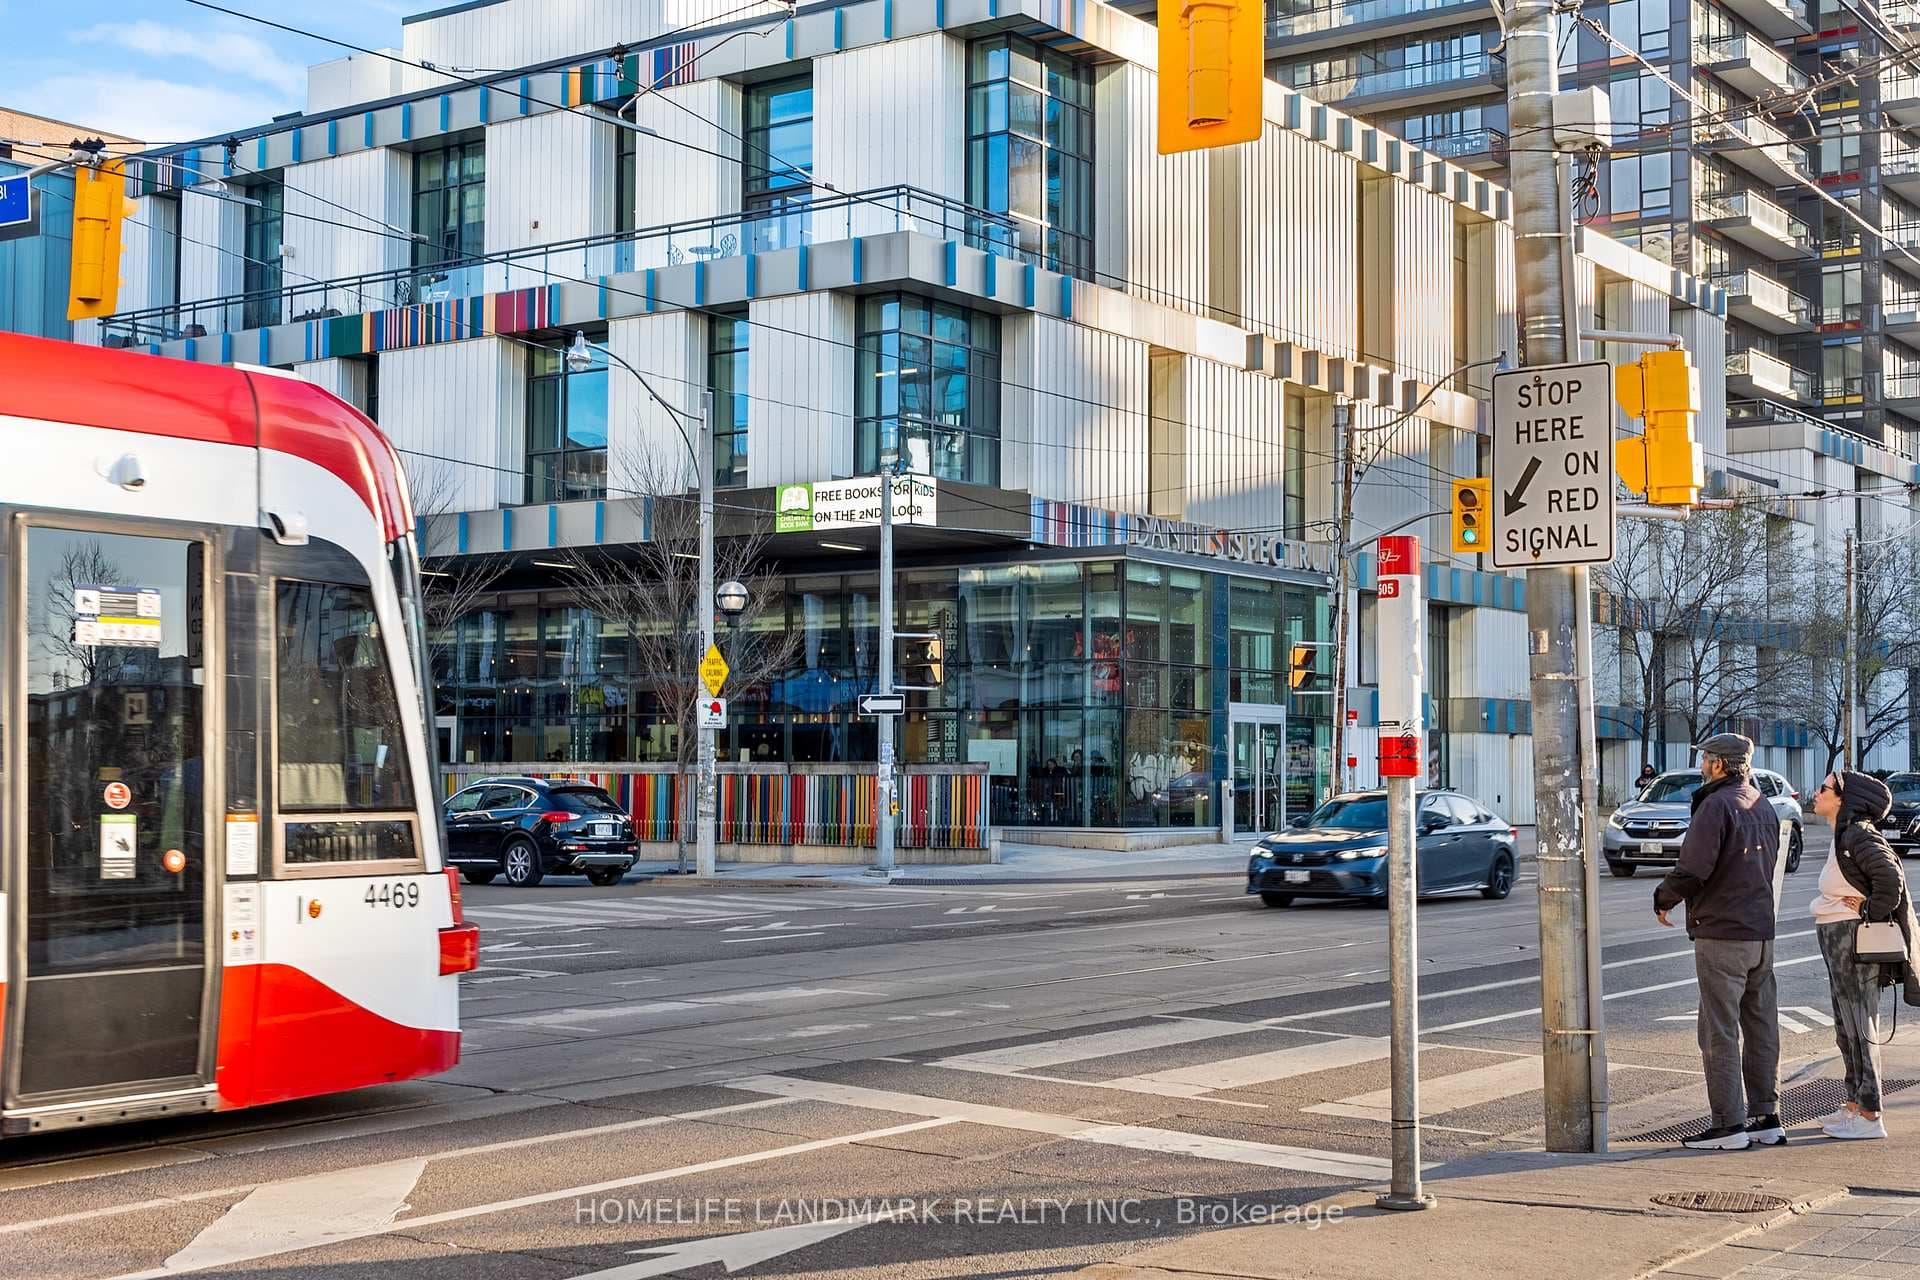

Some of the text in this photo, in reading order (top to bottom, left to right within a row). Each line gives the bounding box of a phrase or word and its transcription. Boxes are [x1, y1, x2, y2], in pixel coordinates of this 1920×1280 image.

[1517, 379, 1582, 408] STOP
[1515, 415, 1584, 445] HERE
[1564, 450, 1599, 476] ON
[815, 484, 935, 502] FREE BOOKS OR KIDS
[1548, 487, 1599, 513] RED
[814, 504, 923, 523] ON THE 2ND LOOR
[1135, 514, 1227, 558] DANIELS
[1506, 523, 1598, 553] SIGNAL
[706, 657, 723, 666] TRAFFIC
[709, 679, 720, 688] ZONE
[365, 882, 419, 908] 4469
